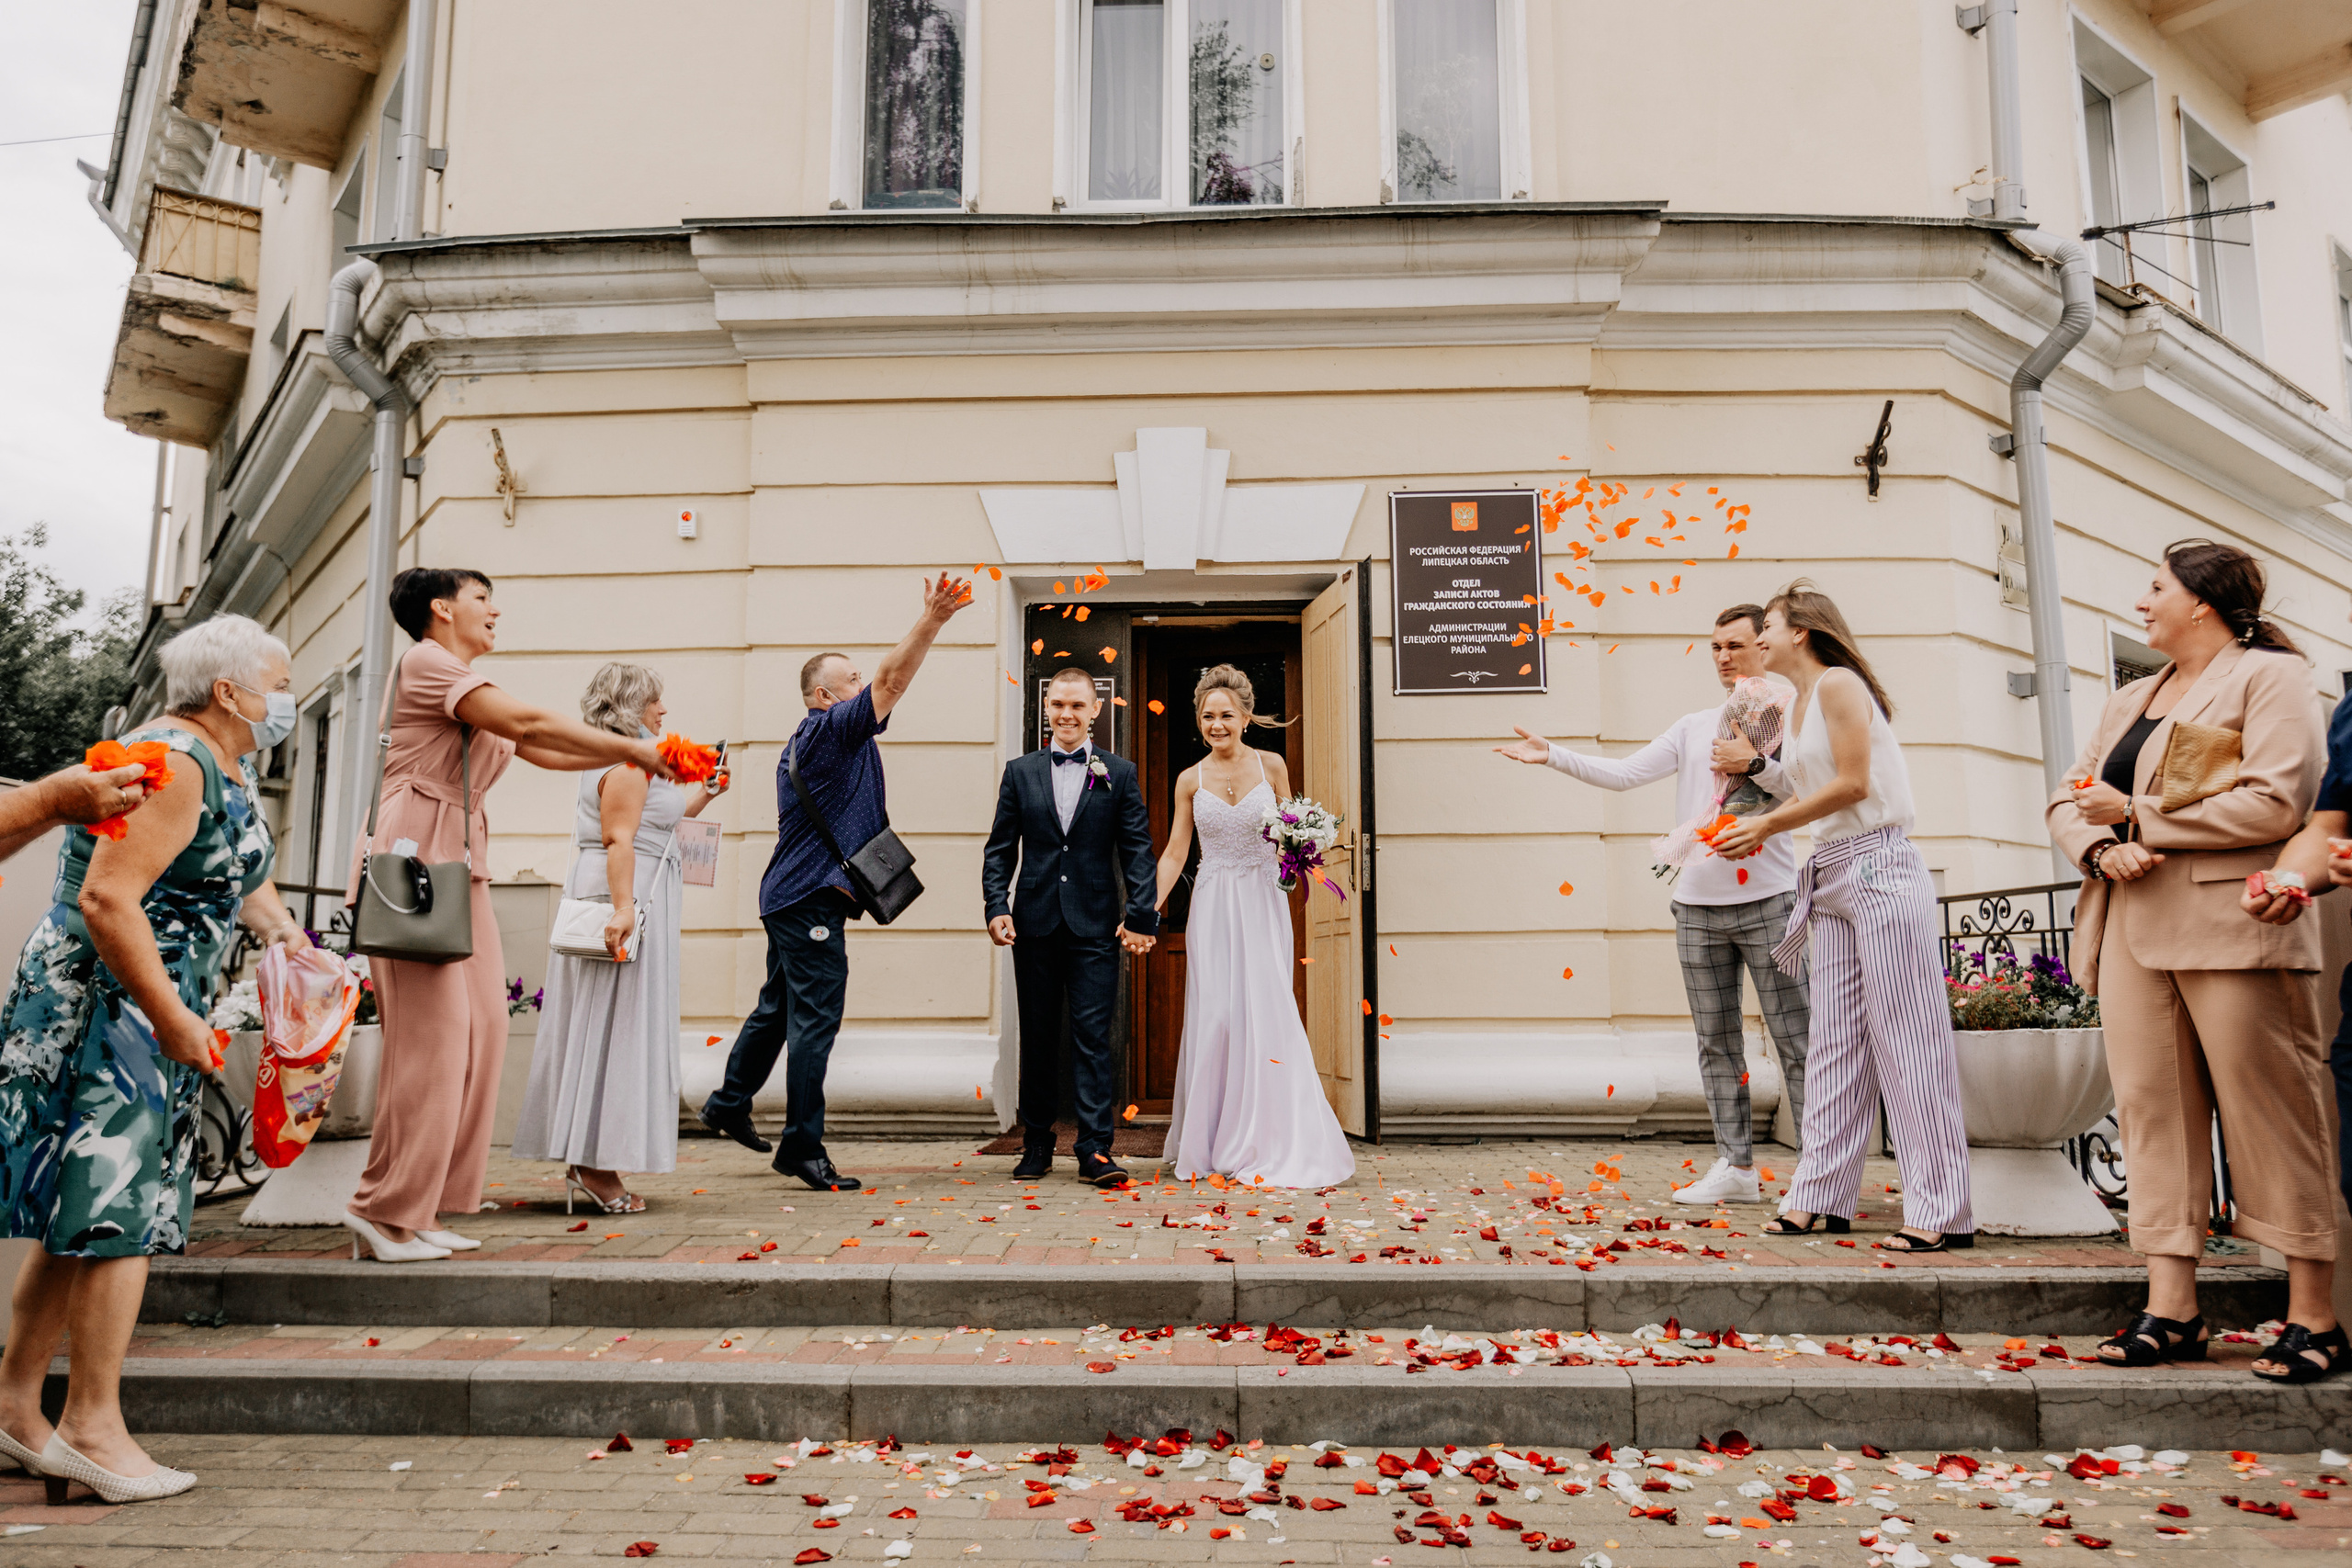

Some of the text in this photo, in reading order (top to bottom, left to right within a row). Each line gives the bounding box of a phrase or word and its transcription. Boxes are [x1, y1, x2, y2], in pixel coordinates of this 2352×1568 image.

[1409, 545, 1521, 556] РОССИЙСКАЯ ФЕДЕРАЦИЯ
[1421, 557, 1510, 567] ЛИПЕЦКАЯ ОБЛАСТЬ
[1452, 579, 1481, 588] ОТДЕЛ
[1433, 590, 1500, 599] ЗАПИСИ АКТОВ
[1404, 602, 1476, 611] ГРАЖДАНСКОГО
[1429, 623, 1507, 633] АДМИНИСТРАЦИИ
[1403, 633, 1534, 645] ЕЛЕЦКОГО МУНИЦИПАЛЬНО
[1451, 645, 1487, 654] РАЙОНА
